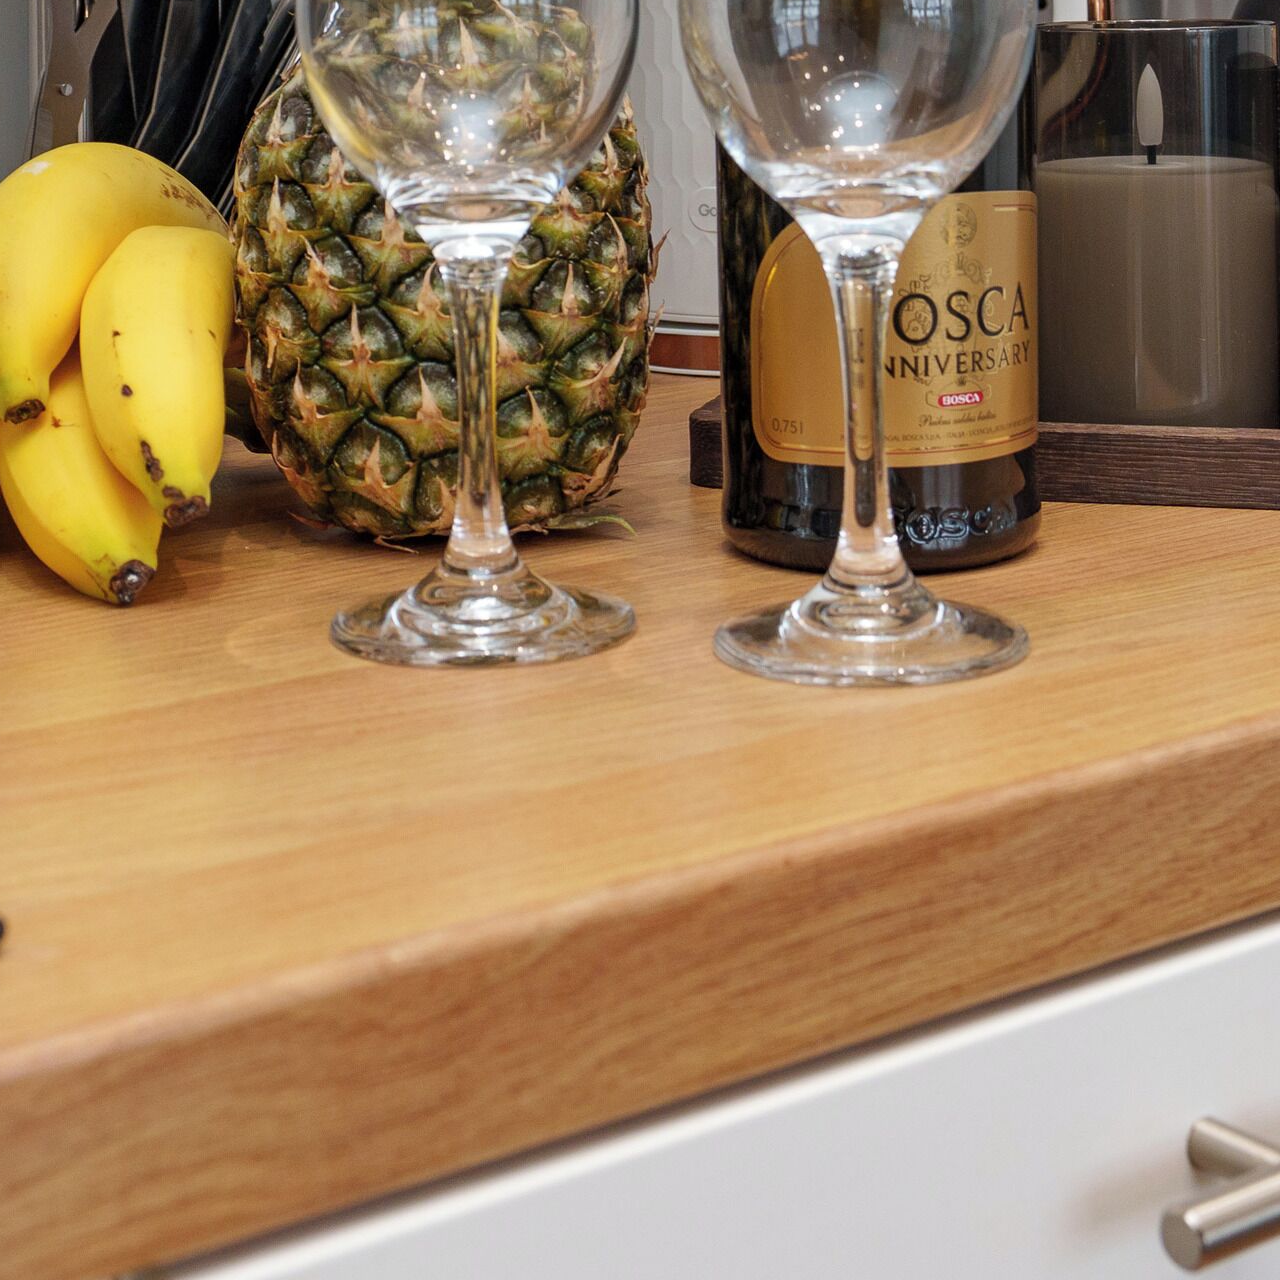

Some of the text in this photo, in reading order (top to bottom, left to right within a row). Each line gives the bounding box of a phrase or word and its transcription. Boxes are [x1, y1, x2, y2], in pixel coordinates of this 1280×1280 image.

[892, 280, 1030, 347] OSCA
[884, 339, 1031, 379] NNIVERSARY
[942, 392, 981, 406] BOSCA
